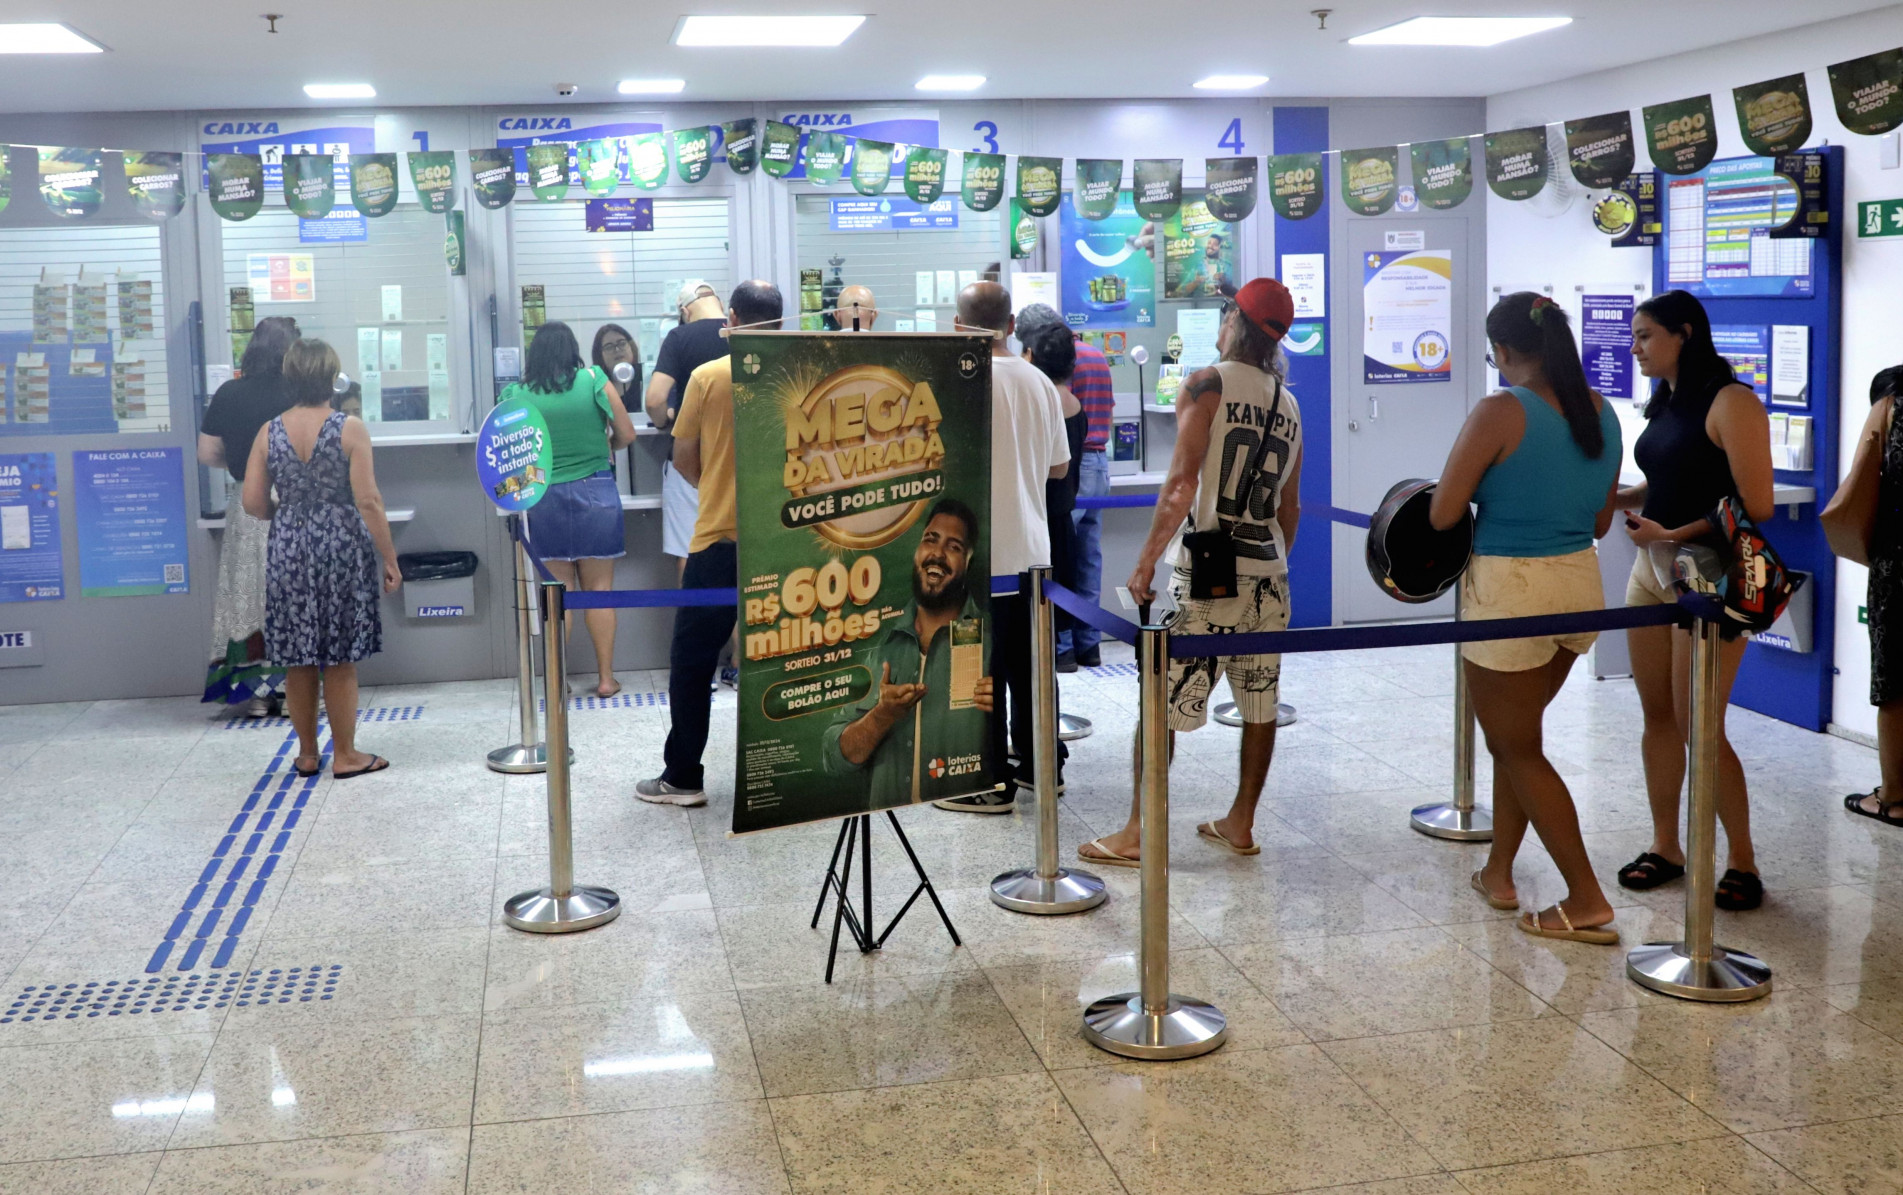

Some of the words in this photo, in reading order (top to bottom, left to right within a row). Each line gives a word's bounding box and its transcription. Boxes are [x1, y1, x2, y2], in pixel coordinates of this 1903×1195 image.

[1853, 80, 1890, 99] VIAJAR
[1859, 85, 1898, 106] MUNDO
[1854, 97, 1889, 115] TODO?
[499, 118, 572, 130] CAIXA
[782, 114, 853, 126] CAIXA
[1666, 113, 1705, 134] 600
[203, 122, 280, 135] CAIXA
[412, 131, 429, 152] 1
[972, 120, 999, 154] 3
[1217, 118, 1245, 155] 4
[1656, 129, 1707, 151] milhões
[708, 125, 726, 163] 2
[1573, 134, 1627, 156] COLECIONAR
[1501, 152, 1533, 167] MORAR
[1581, 144, 1620, 161] CARROS?
[424, 165, 450, 180] 600
[475, 166, 511, 180] COLECIONAR
[918, 160, 942, 172] 600
[974, 167, 1000, 179] 600
[1349, 162, 1394, 180] MEGA
[1427, 163, 1455, 176] VIAJAR
[1503, 160, 1532, 173] NUMA
[131, 173, 179, 185] COLECIONAR
[481, 173, 506, 185] CARROS?
[909, 172, 940, 182] milhões
[1284, 167, 1315, 185] 600
[1430, 169, 1462, 183] MUNDO
[1497, 165, 1540, 182] MANSÃO?
[139, 180, 173, 191] CARROS?
[221, 177, 250, 187] MORAR
[224, 184, 248, 194] NUMA
[297, 177, 323, 187] VIAJAR
[301, 183, 328, 194] MUNDO
[965, 179, 998, 189] milhões
[1086, 181, 1110, 189] VIAJAR
[1144, 180, 1170, 190] MORAR
[1210, 176, 1253, 190] COLECIONAR
[1274, 182, 1315, 196] milhões
[1427, 179, 1455, 191] TODO?
[218, 190, 256, 202] MANSÃO?
[298, 191, 323, 201] TODO?
[1088, 186, 1114, 195] MUNDO
[1146, 187, 1168, 196] NUMA
[1215, 184, 1247, 196] CARROS?
[1084, 193, 1107, 202] TODO?
[1139, 192, 1174, 203] MANSÃO?
[1419, 343, 1444, 357] 18+
[961, 359, 977, 371] 18+
[785, 381, 943, 450] MEGA
[491, 425, 534, 449] Diversão
[486, 446, 497, 467] $
[501, 450, 509, 459] a
[510, 440, 533, 456] todo
[535, 428, 543, 452] $
[88, 453, 108, 461] FALE
[109, 452, 130, 460] COM
[139, 450, 166, 459] CAIXA
[784, 454, 831, 489] DA
[834, 431, 946, 481] VIRADA
[497, 452, 538, 475] instante
[789, 497, 835, 522] VOCÊ
[841, 488, 885, 511] PODE
[890, 475, 941, 500] TUDO!
[1740, 535, 1757, 604] SPARK
[752, 573, 778, 584] PRÊMIO
[744, 581, 778, 593] ESTIMADO
[745, 592, 781, 625] R$
[781, 555, 882, 618] 600
[418, 607, 463, 617] Lixeira
[745, 608, 881, 660] milhões
[1756, 633, 1792, 649] Lixeira
[784, 656, 821, 672] SORTEIO
[823, 648, 852, 664] 31/12
[780, 682, 822, 699] COMPRE
[824, 680, 833, 690] O
[834, 674, 853, 687] SEU
[788, 694, 822, 711] BOLÃO
[824, 687, 850, 702] AQUI
[948, 753, 981, 766] loterias
[948, 762, 982, 776] CAIXA
